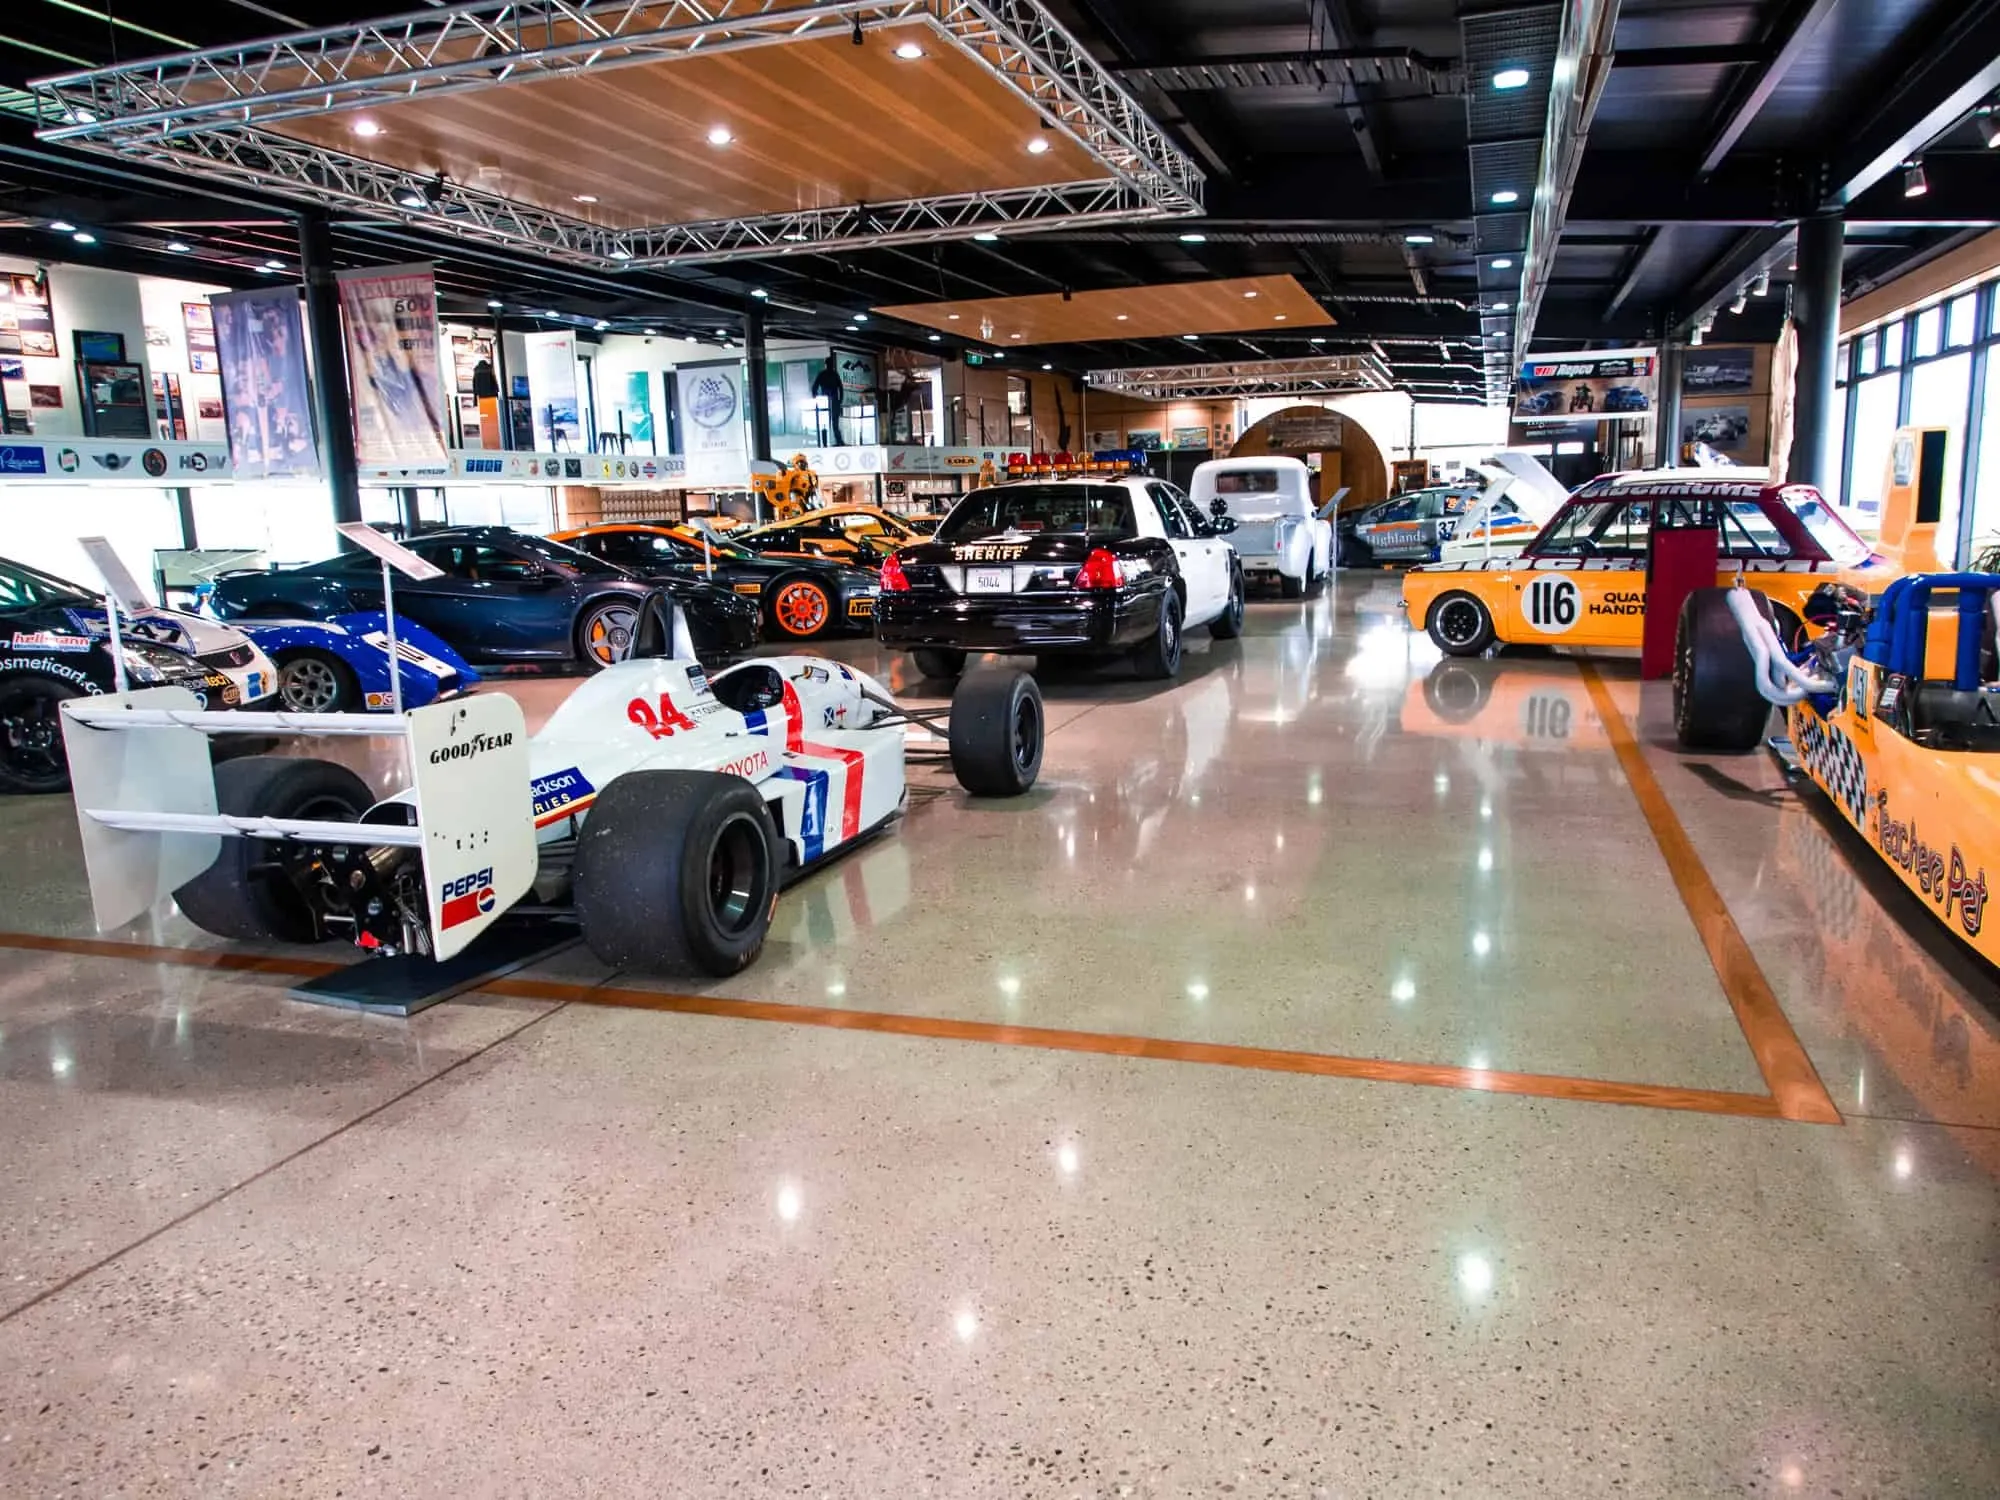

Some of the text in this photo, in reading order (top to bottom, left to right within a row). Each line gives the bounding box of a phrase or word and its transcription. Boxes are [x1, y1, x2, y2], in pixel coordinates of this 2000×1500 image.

[1366, 530, 1426, 546] Highlands
[1438, 520, 1456, 535] 37
[954, 550, 1022, 561] SHERIFF
[1532, 582, 1575, 625] 116
[627, 692, 696, 740] 24
[430, 732, 513, 764] GOODYEAR
[442, 866, 493, 902] PEPSI
[1945, 847, 1988, 935] Pet
